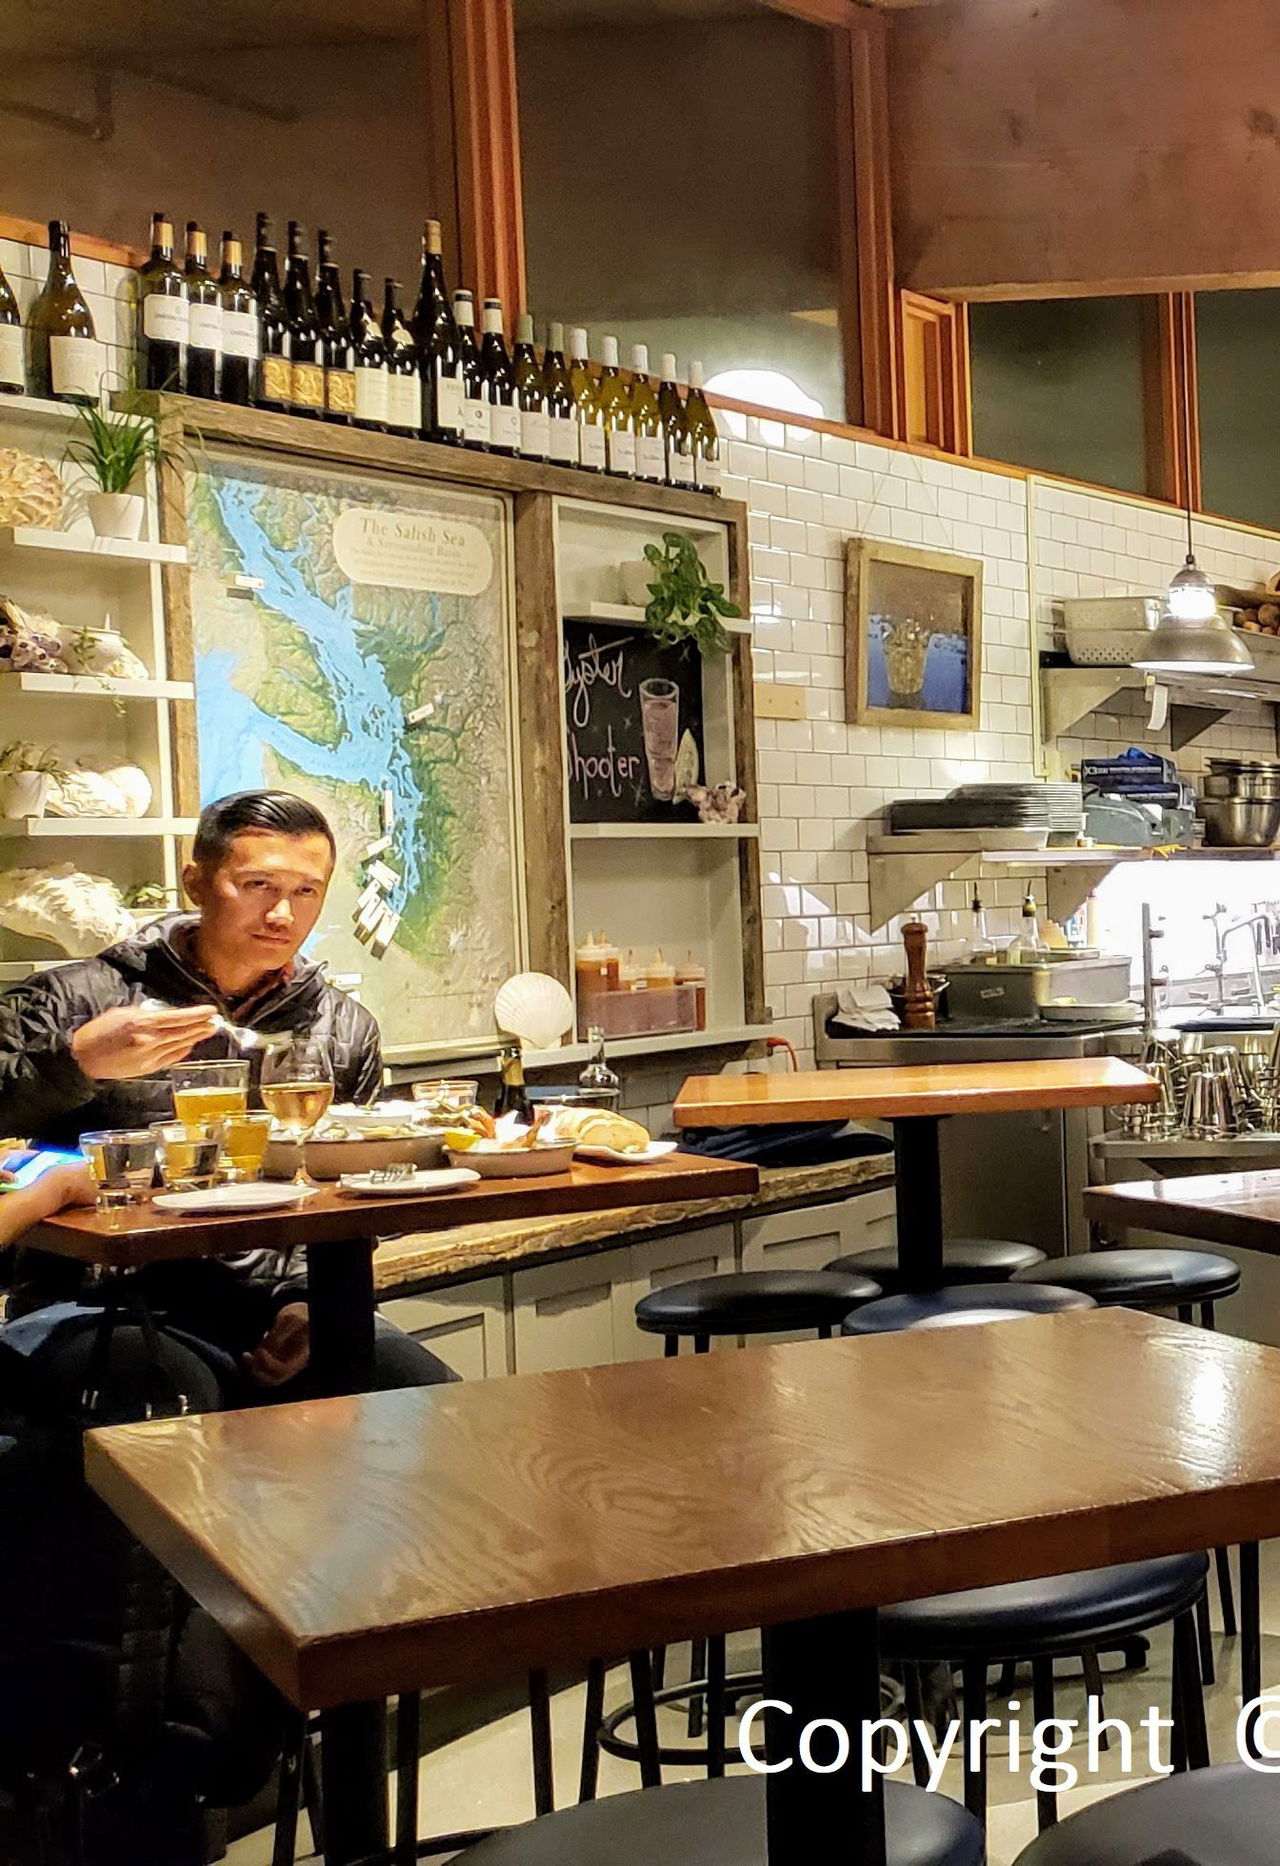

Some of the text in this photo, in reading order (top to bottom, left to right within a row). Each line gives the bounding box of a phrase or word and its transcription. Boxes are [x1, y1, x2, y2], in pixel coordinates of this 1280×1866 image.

[360, 517, 465, 547] The Salish Sea
